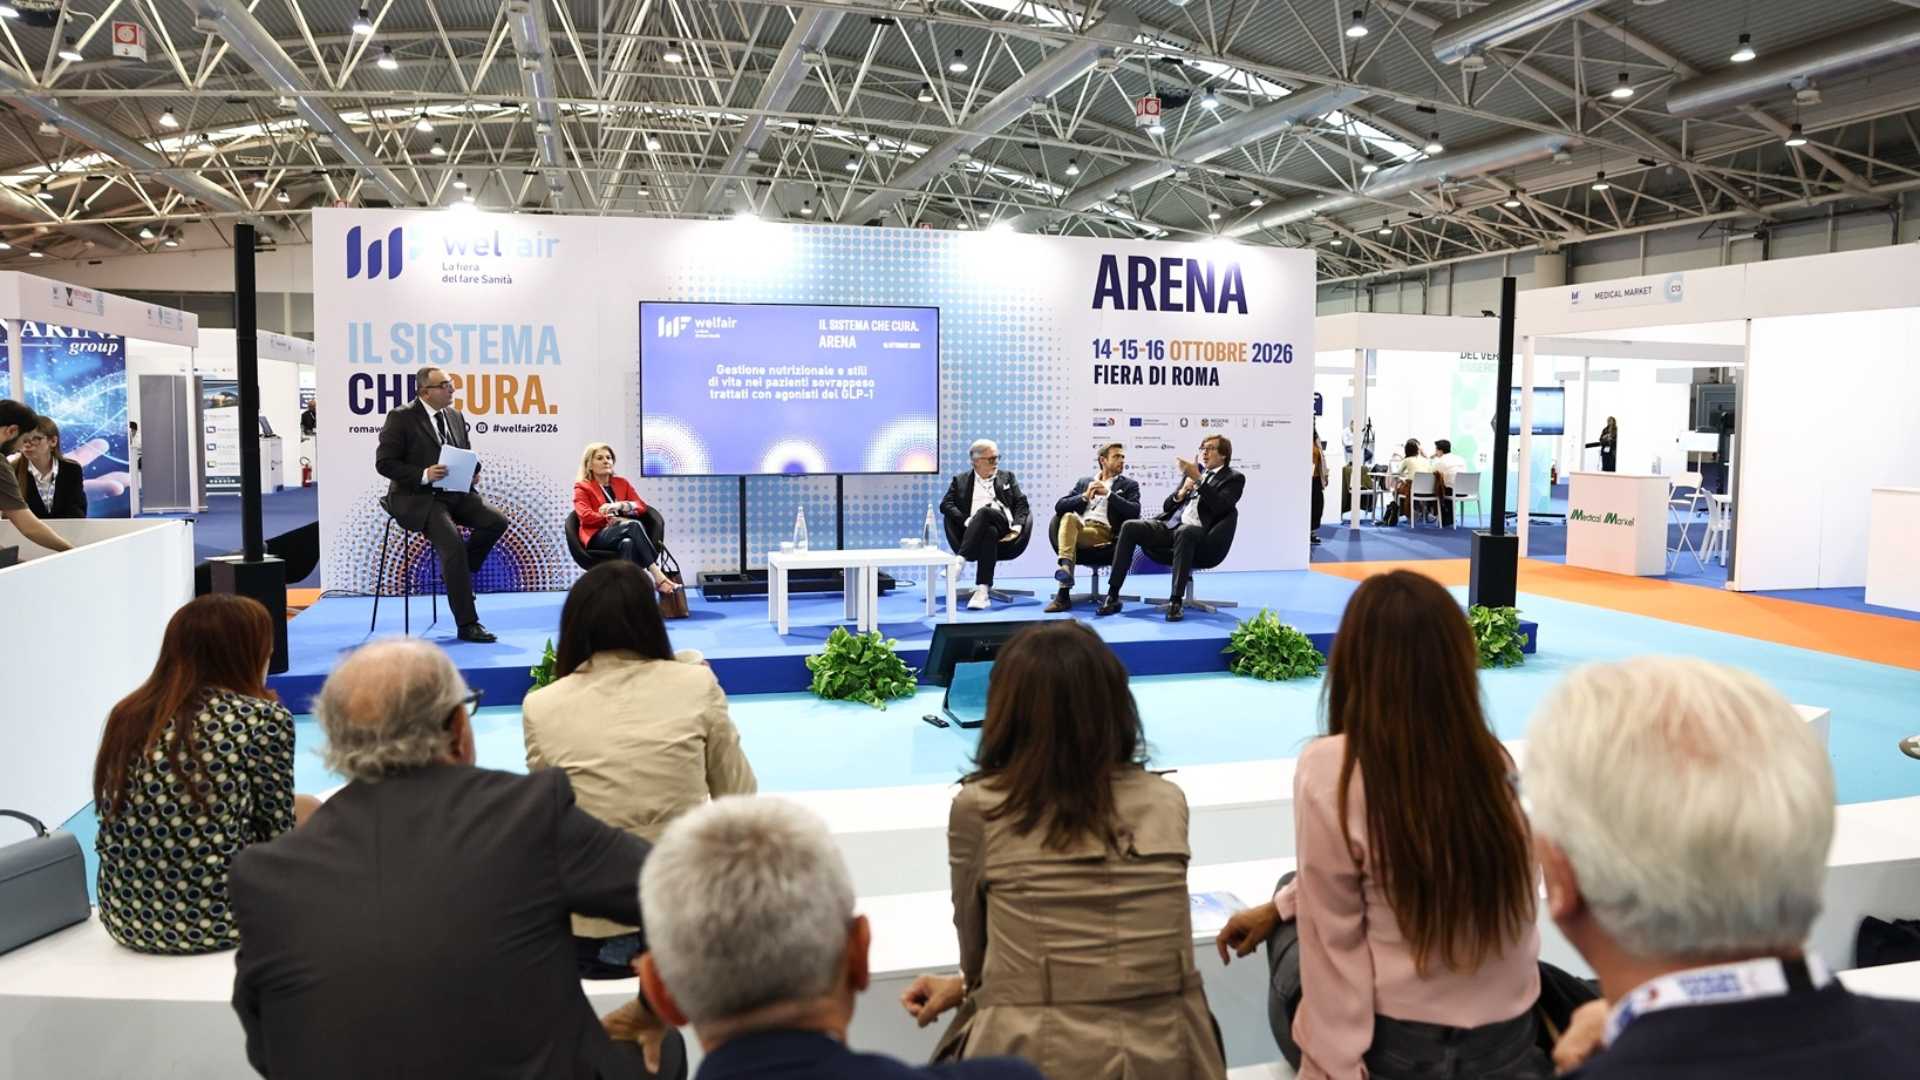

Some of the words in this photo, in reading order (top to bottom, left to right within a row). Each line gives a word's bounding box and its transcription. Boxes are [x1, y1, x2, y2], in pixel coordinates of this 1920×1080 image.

[443, 230, 561, 258] welair
[442, 262, 454, 271] La
[456, 262, 480, 271] fiera
[442, 274, 457, 283] del
[459, 274, 479, 283] fare
[481, 274, 512, 284] Sanità
[1092, 254, 1248, 314] ARENA
[1595, 291, 1622, 300] MEDICAL
[1624, 286, 1652, 296] MARKET
[695, 316, 737, 329] welfair
[819, 319, 827, 331] IL
[829, 319, 869, 331] SISTEMA
[871, 320, 890, 332] CHE
[68, 342, 118, 356] group
[348, 321, 383, 364] IL
[390, 322, 561, 366] SISTEMA
[818, 335, 857, 349] ARENA
[1092, 338, 1165, 361] 14-15-16
[1169, 340, 1247, 362] OTTOBRE
[1252, 343, 1293, 364] 2026
[716, 364, 766, 375] Gestione
[768, 364, 834, 376] nutrizionale
[837, 367, 844, 376] e
[847, 365, 867, 376] stili
[1094, 365, 1143, 385] FIERA
[1149, 366, 1166, 385] DI
[1172, 366, 1220, 386] ROMA
[708, 376, 718, 387] di
[722, 376, 741, 387] vita
[766, 377, 809, 390] pazienti
[812, 378, 875, 390] sovrappeso
[709, 388, 748, 399] trattati
[752, 390, 772, 399] con
[775, 388, 818, 402] agonisti
[841, 387, 873, 399] GLP-1
[349, 426, 384, 434] romaw
[493, 424, 558, 434] #welfair2026
[1570, 508, 1601, 523] Medical
